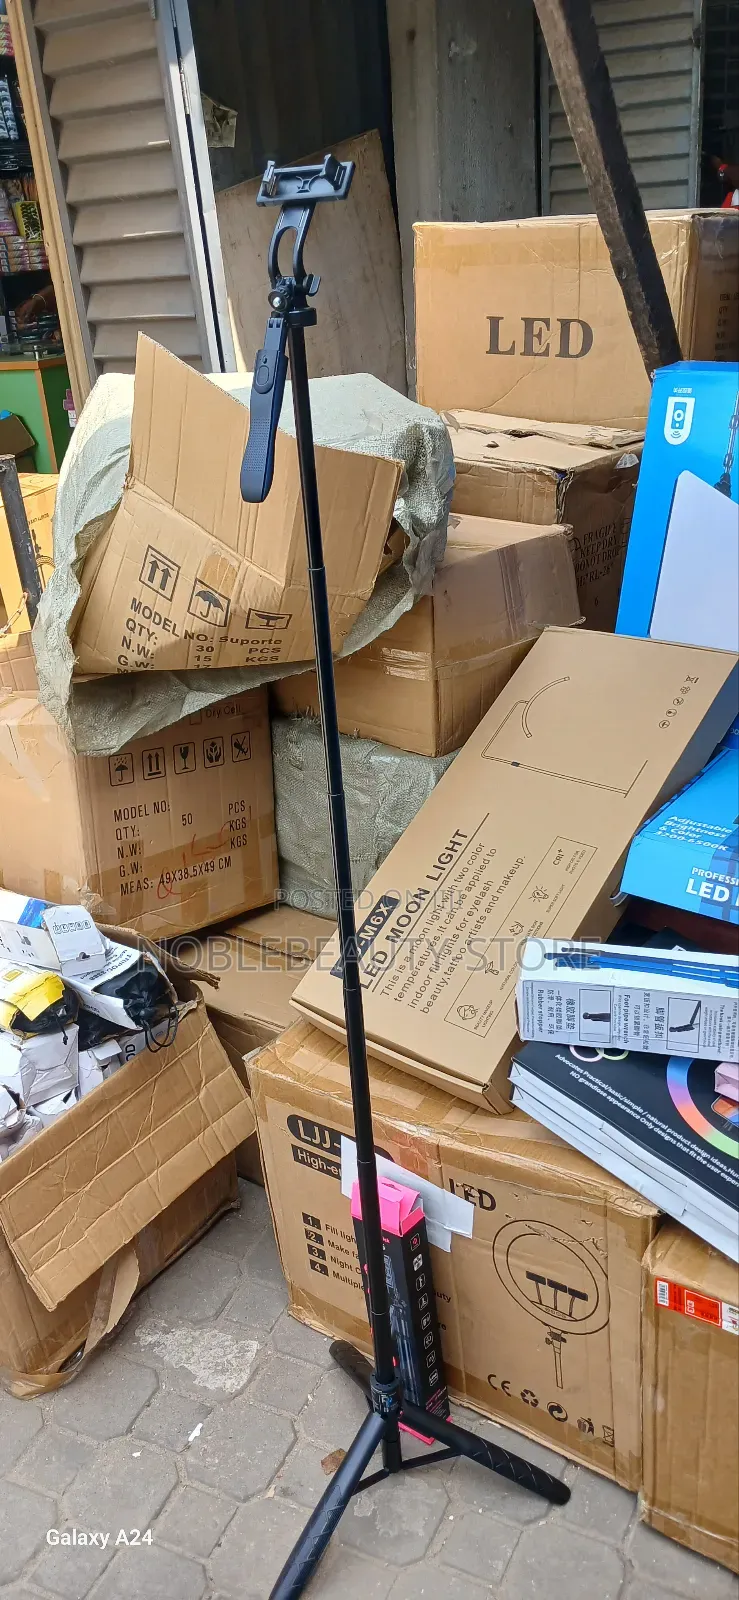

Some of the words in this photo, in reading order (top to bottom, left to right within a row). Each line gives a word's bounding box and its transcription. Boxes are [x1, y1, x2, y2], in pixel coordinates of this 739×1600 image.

[486, 316, 593, 358] LED
[126, 618, 158, 646] QTY:
[196, 644, 215, 654] 30
[248, 646, 281, 654] PCS
[130, 597, 180, 638] MODEL
[184, 629, 214, 643] NO:
[219, 636, 282, 646] Suporte
[118, 655, 155, 670] G.W:
[121, 636, 156, 660] N.W:
[194, 654, 212, 662] 15
[114, 804, 150, 822] MODEL
[154, 800, 170, 814] NO:
[116, 824, 140, 841] QTY:
[182, 813, 193, 826] 50
[228, 800, 246, 816] PCS
[664, 820, 727, 838] Brightness
[668, 816, 732, 834] Adjustable
[117, 842, 142, 860] N.W:
[229, 817, 247, 832] KGS
[670, 828, 702, 839] Color
[119, 860, 143, 878] G.W:
[230, 834, 248, 850] KGS
[120, 877, 154, 896] MEAS:
[158, 860, 215, 886] 49X38.5X49
[218, 856, 232, 870] CM
[444, 904, 459, 925] can
[454, 894, 468, 906] be
[465, 858, 490, 894] applied
[487, 848, 497, 858] to
[464, 915, 487, 946] artists
[484, 894, 500, 914] and
[496, 856, 526, 894] makeup.
[686, 878, 730, 902] LED
[360, 950, 388, 990] LED
[385, 887, 430, 944] MOON
[426, 828, 468, 882] LIGHT
[380, 973, 400, 997] This
[398, 963, 406, 974] is
[409, 929, 429, 956] moon
[426, 903, 446, 929] light
[441, 884, 458, 905] with
[454, 868, 470, 884] two
[468, 842, 485, 866] color
[408, 974, 433, 1009] indoor
[437, 932, 460, 963] lights
[456, 918, 469, 933] for
[466, 880, 494, 918] eyelash
[555, 1054, 584, 1074] Advocates
[646, 1114, 669, 1130] natural
[666, 1128, 692, 1146] product
[690, 1144, 711, 1160] design
[570, 1070, 580, 1079] NO
[578, 1077, 608, 1098] grandiose
[606, 1095, 641, 1120] appearance
[640, 1116, 654, 1130] Only
[654, 1126, 677, 1145] designs
[676, 1142, 690, 1154] that
[688, 1150, 697, 1158] fit
[696, 1156, 708, 1166] the
[706, 1163, 722, 1174] user
[308, 1216, 318, 1228] 1.
[325, 1224, 338, 1236] Fill
[309, 1232, 320, 1243] 2.
[328, 1240, 350, 1256] Make
[312, 1248, 322, 1258] 3.
[330, 1256, 353, 1272] Night
[314, 1263, 325, 1274] 4.
